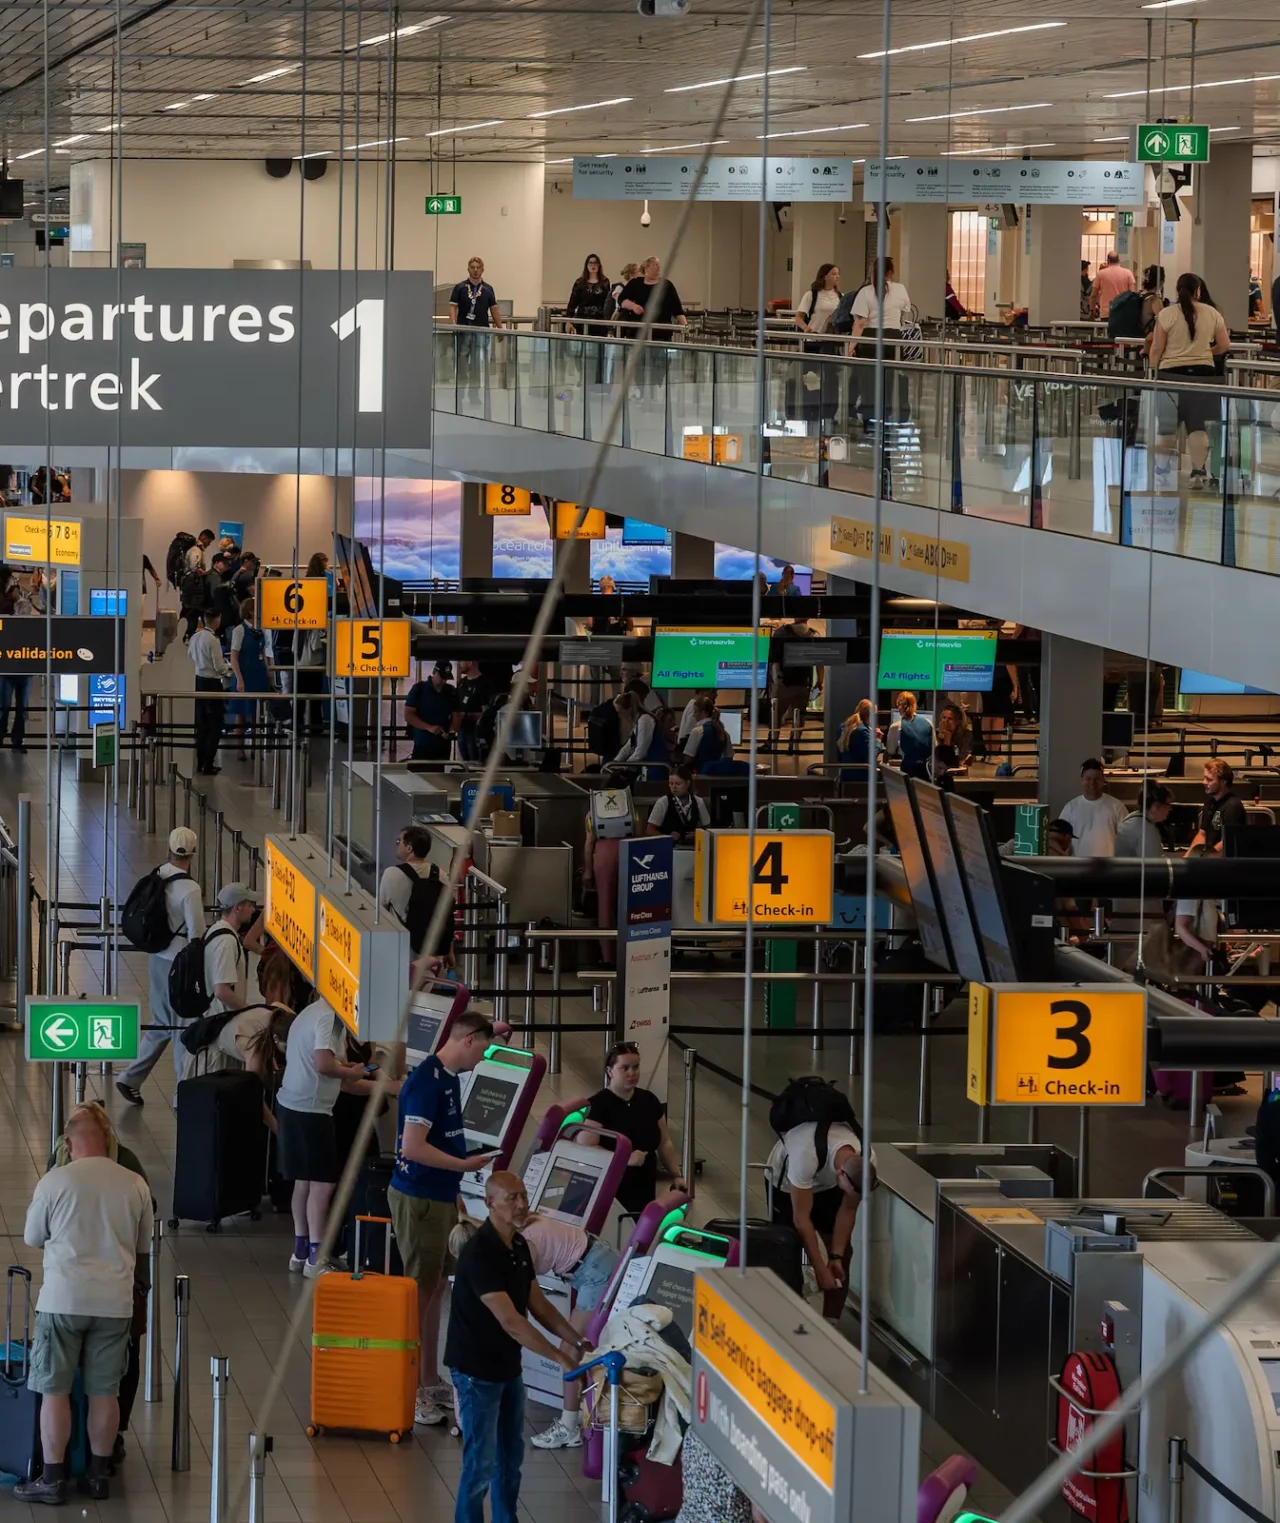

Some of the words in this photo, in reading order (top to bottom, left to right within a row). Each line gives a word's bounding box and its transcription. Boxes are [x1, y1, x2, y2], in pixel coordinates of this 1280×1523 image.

[330, 299, 384, 412] 1
[500, 485, 516, 505] 8
[24, 525, 46, 534] Check-in
[56, 526, 62, 538] 7
[64, 526, 70, 540] 8
[493, 541, 534, 551] ocean
[536, 540, 547, 551] of
[844, 528, 852, 542] Gates
[853, 528, 858, 548] D
[866, 530, 891, 556] EFHM
[56, 548, 78, 560] Economy
[941, 548, 946, 568] D
[284, 582, 304, 614] 6
[284, 617, 317, 625] Chck-in
[762, 628, 766, 636] 1
[362, 626, 382, 660] 5
[6, 646, 73, 660] validation
[360, 664, 398, 672] Check-in
[657, 670, 670, 678] All
[672, 670, 704, 679] flights
[882, 672, 896, 680] All
[898, 672, 930, 681] flights
[753, 842, 788, 894] 4
[632, 871, 668, 883] LUFTHANSA
[286, 866, 295, 903] 9-32
[632, 882, 654, 893] GROUP
[630, 912, 641, 920] First
[754, 904, 814, 916] Check-in
[630, 928, 649, 937] Business
[650, 927, 662, 935] Class
[330, 917, 343, 946] Check-in
[344, 927, 352, 964] 1-8
[630, 954, 652, 963] Austrian
[329, 968, 342, 996] Check-in
[638, 985, 660, 994] Lufthansa
[636, 1019, 652, 1028] SWISS
[1047, 1000, 1092, 1070] 3
[1045, 1079, 1120, 1096] Check-in
[540, 1360, 560, 1372] Schiphol
[710, 1312, 754, 1382] Self-service
[757, 1355, 792, 1425] baggage
[795, 1399, 834, 1462] drop-off
[710, 1390, 730, 1438] With
[730, 1412, 768, 1491] boarding
[768, 1461, 789, 1506] pass
[790, 1489, 811, 1523] only
